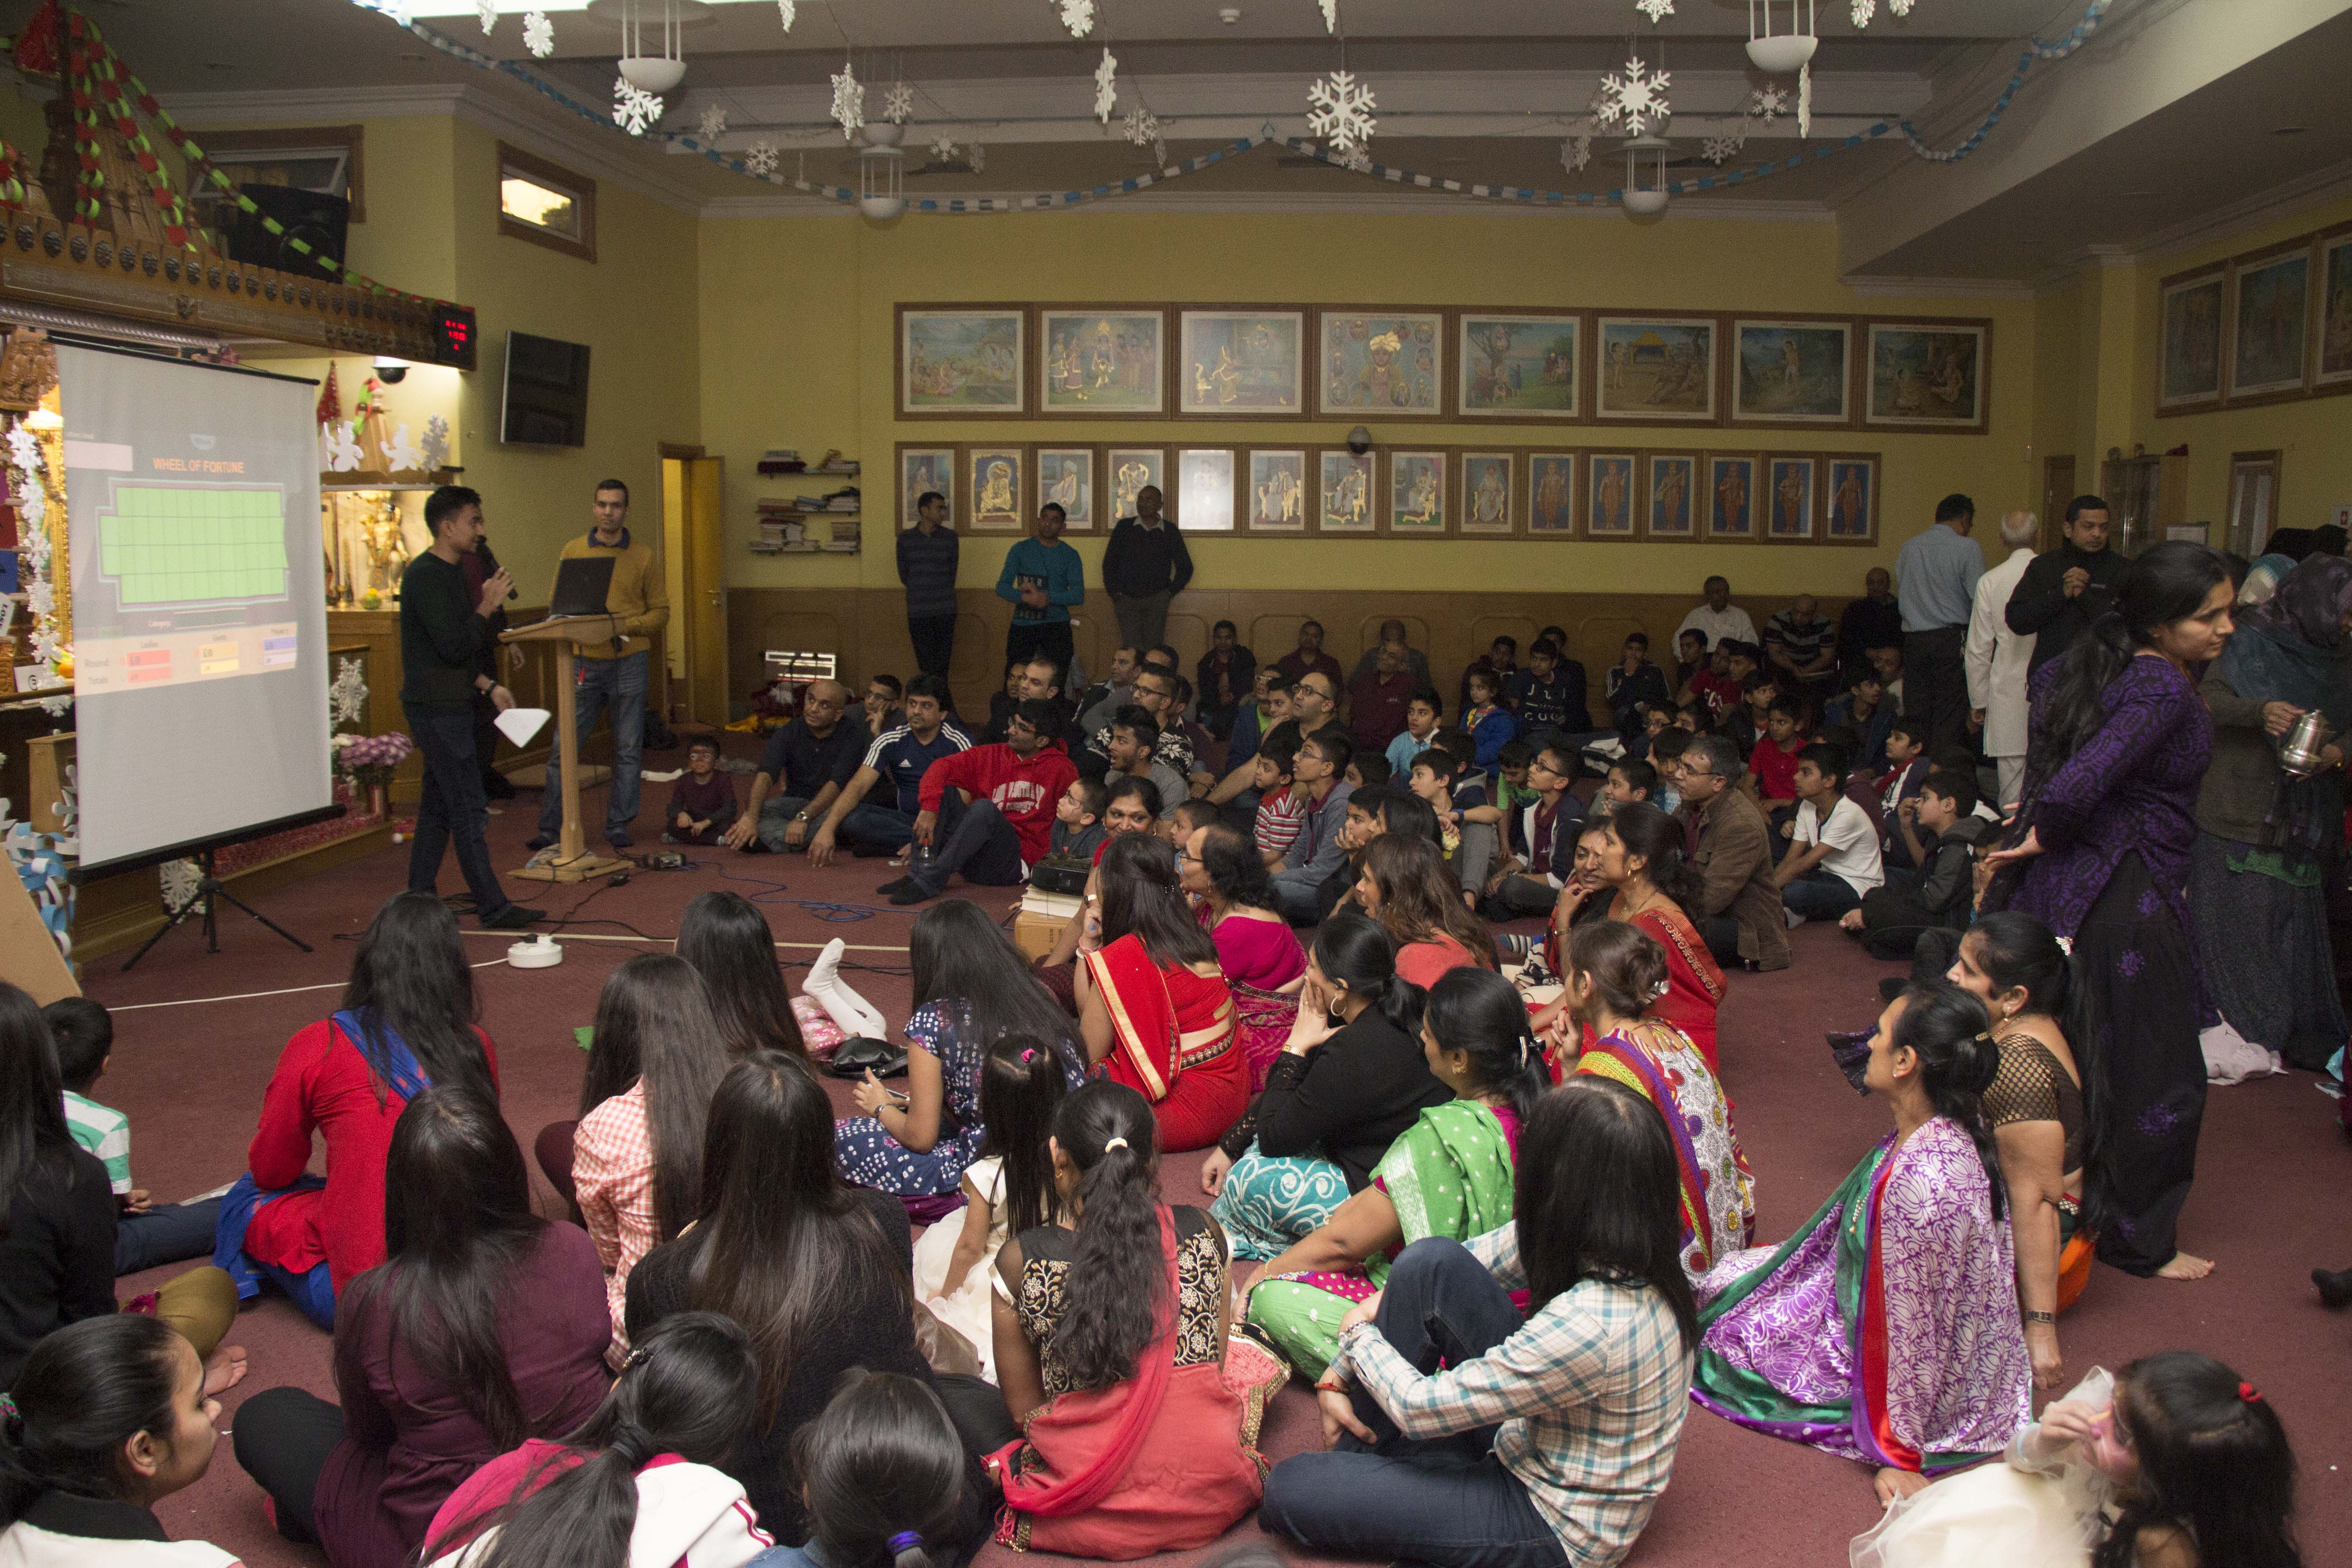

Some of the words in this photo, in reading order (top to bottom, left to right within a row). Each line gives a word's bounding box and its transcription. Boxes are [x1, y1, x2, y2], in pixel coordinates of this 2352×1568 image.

[153, 457, 187, 471] WHEEL
[189, 460, 201, 471] OF
[204, 460, 245, 474] FORTUNE
[84, 658, 109, 668] Round
[88, 676, 108, 685] Totals
